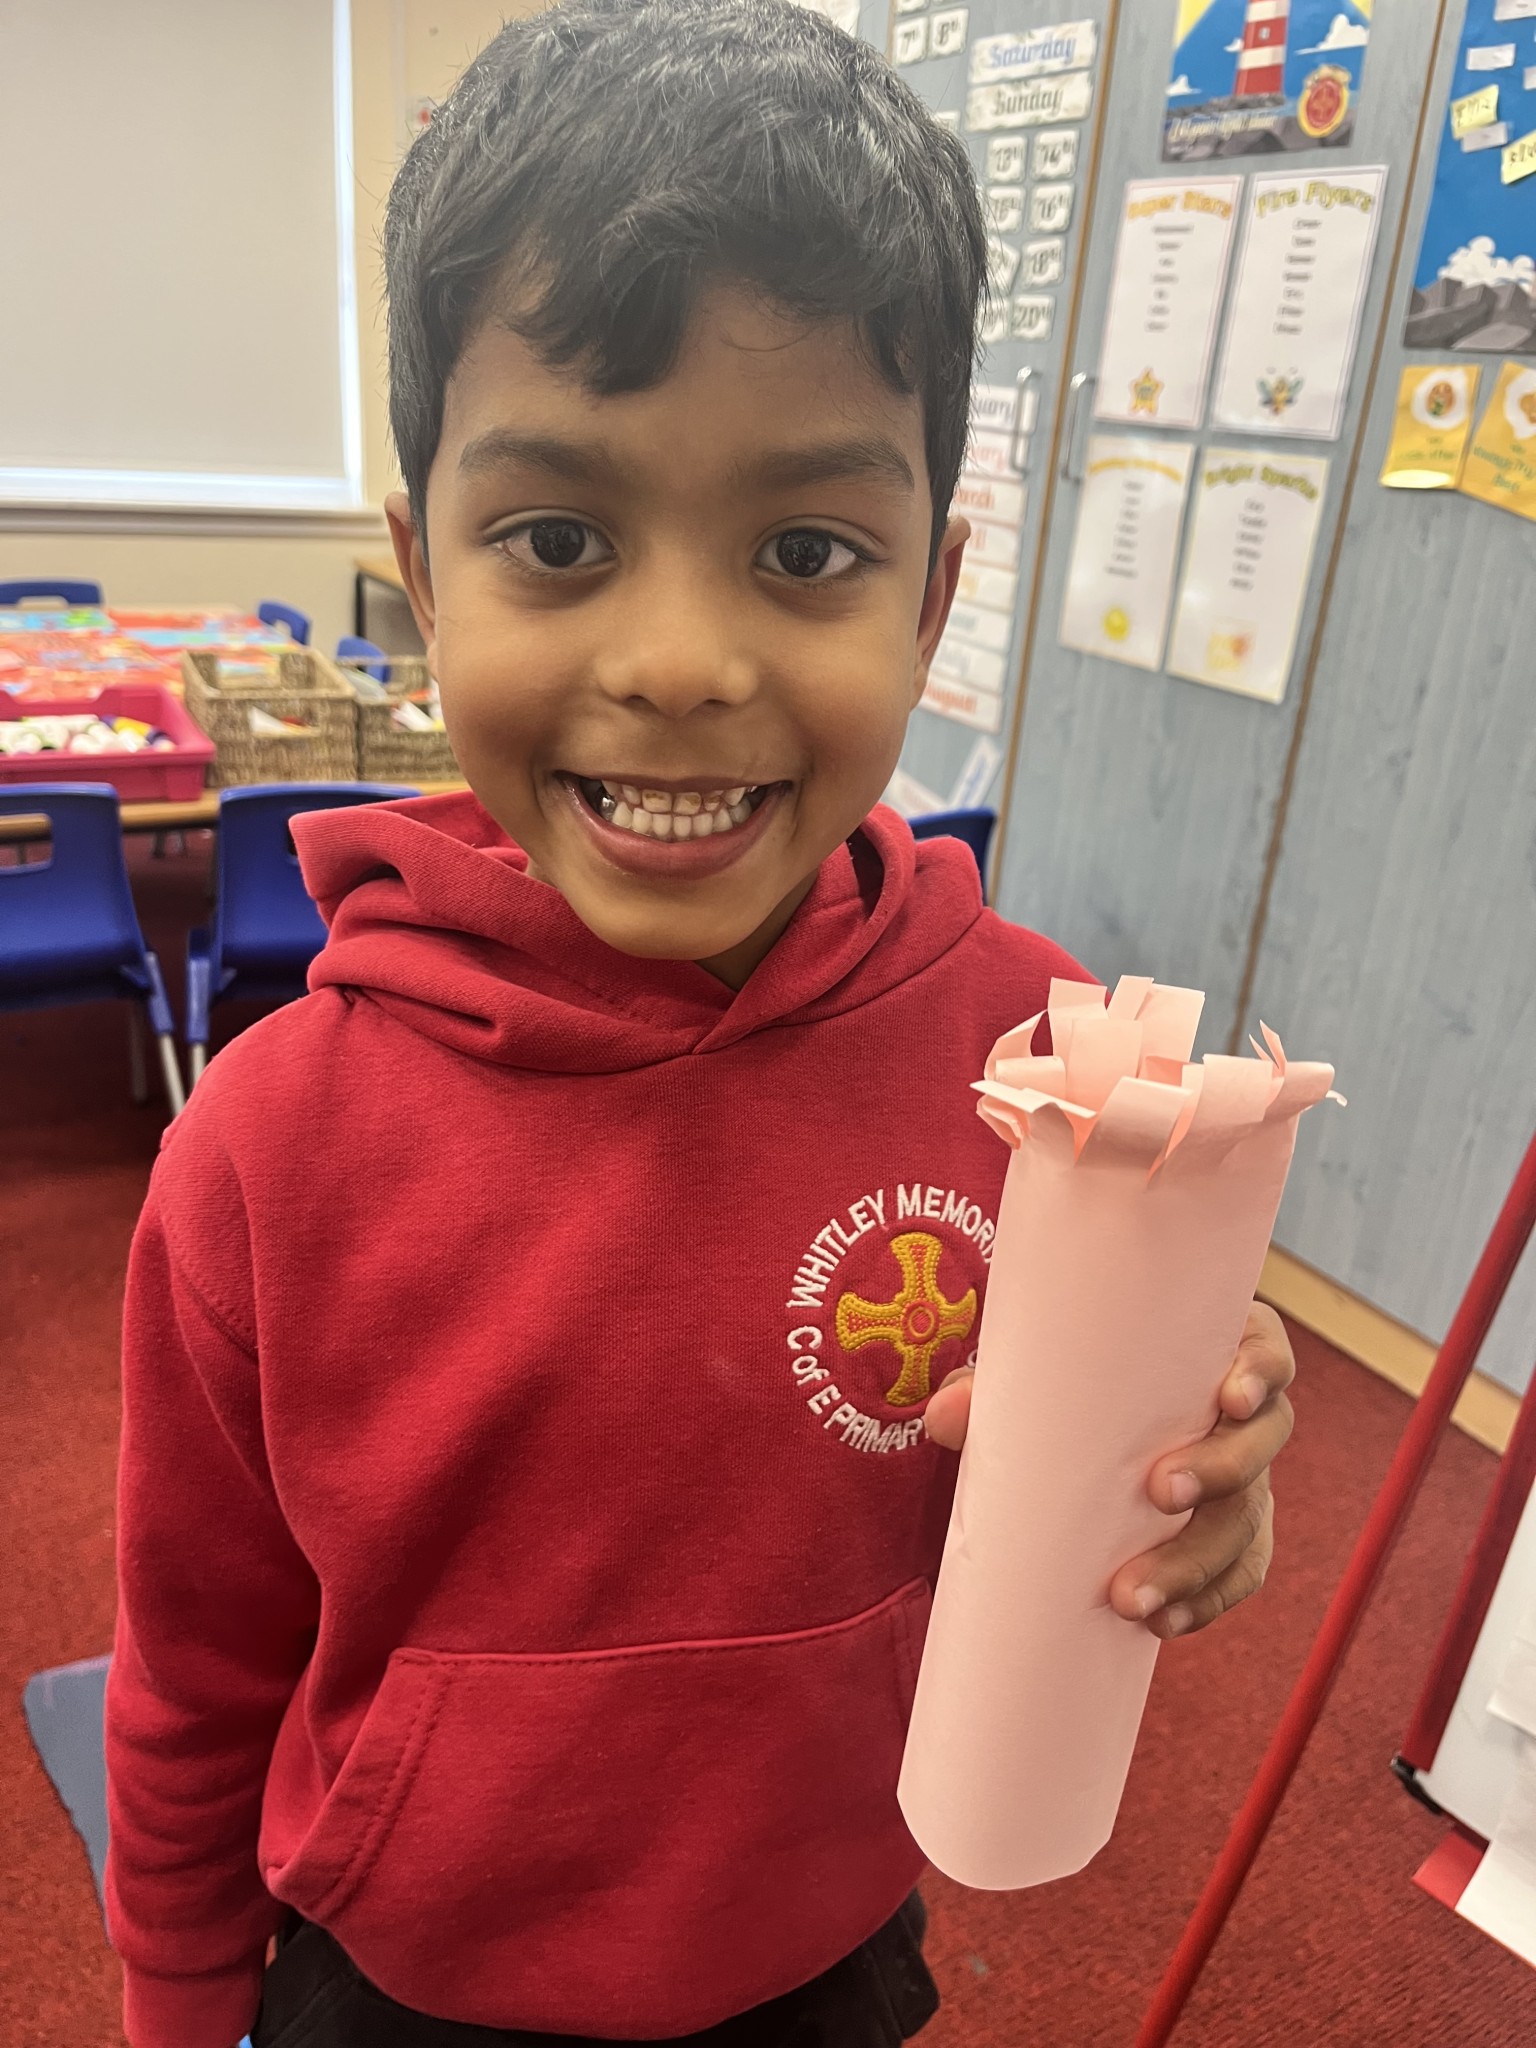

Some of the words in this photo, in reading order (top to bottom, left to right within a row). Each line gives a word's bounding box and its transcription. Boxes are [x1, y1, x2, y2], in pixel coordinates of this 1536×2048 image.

[990, 32, 1077, 68] Saturday
[993, 85, 1064, 118] Sunday
[786, 1188, 886, 1309] WHITLEY
[806, 1383, 842, 1415] E
[822, 1402, 930, 1454] PRIMAR
